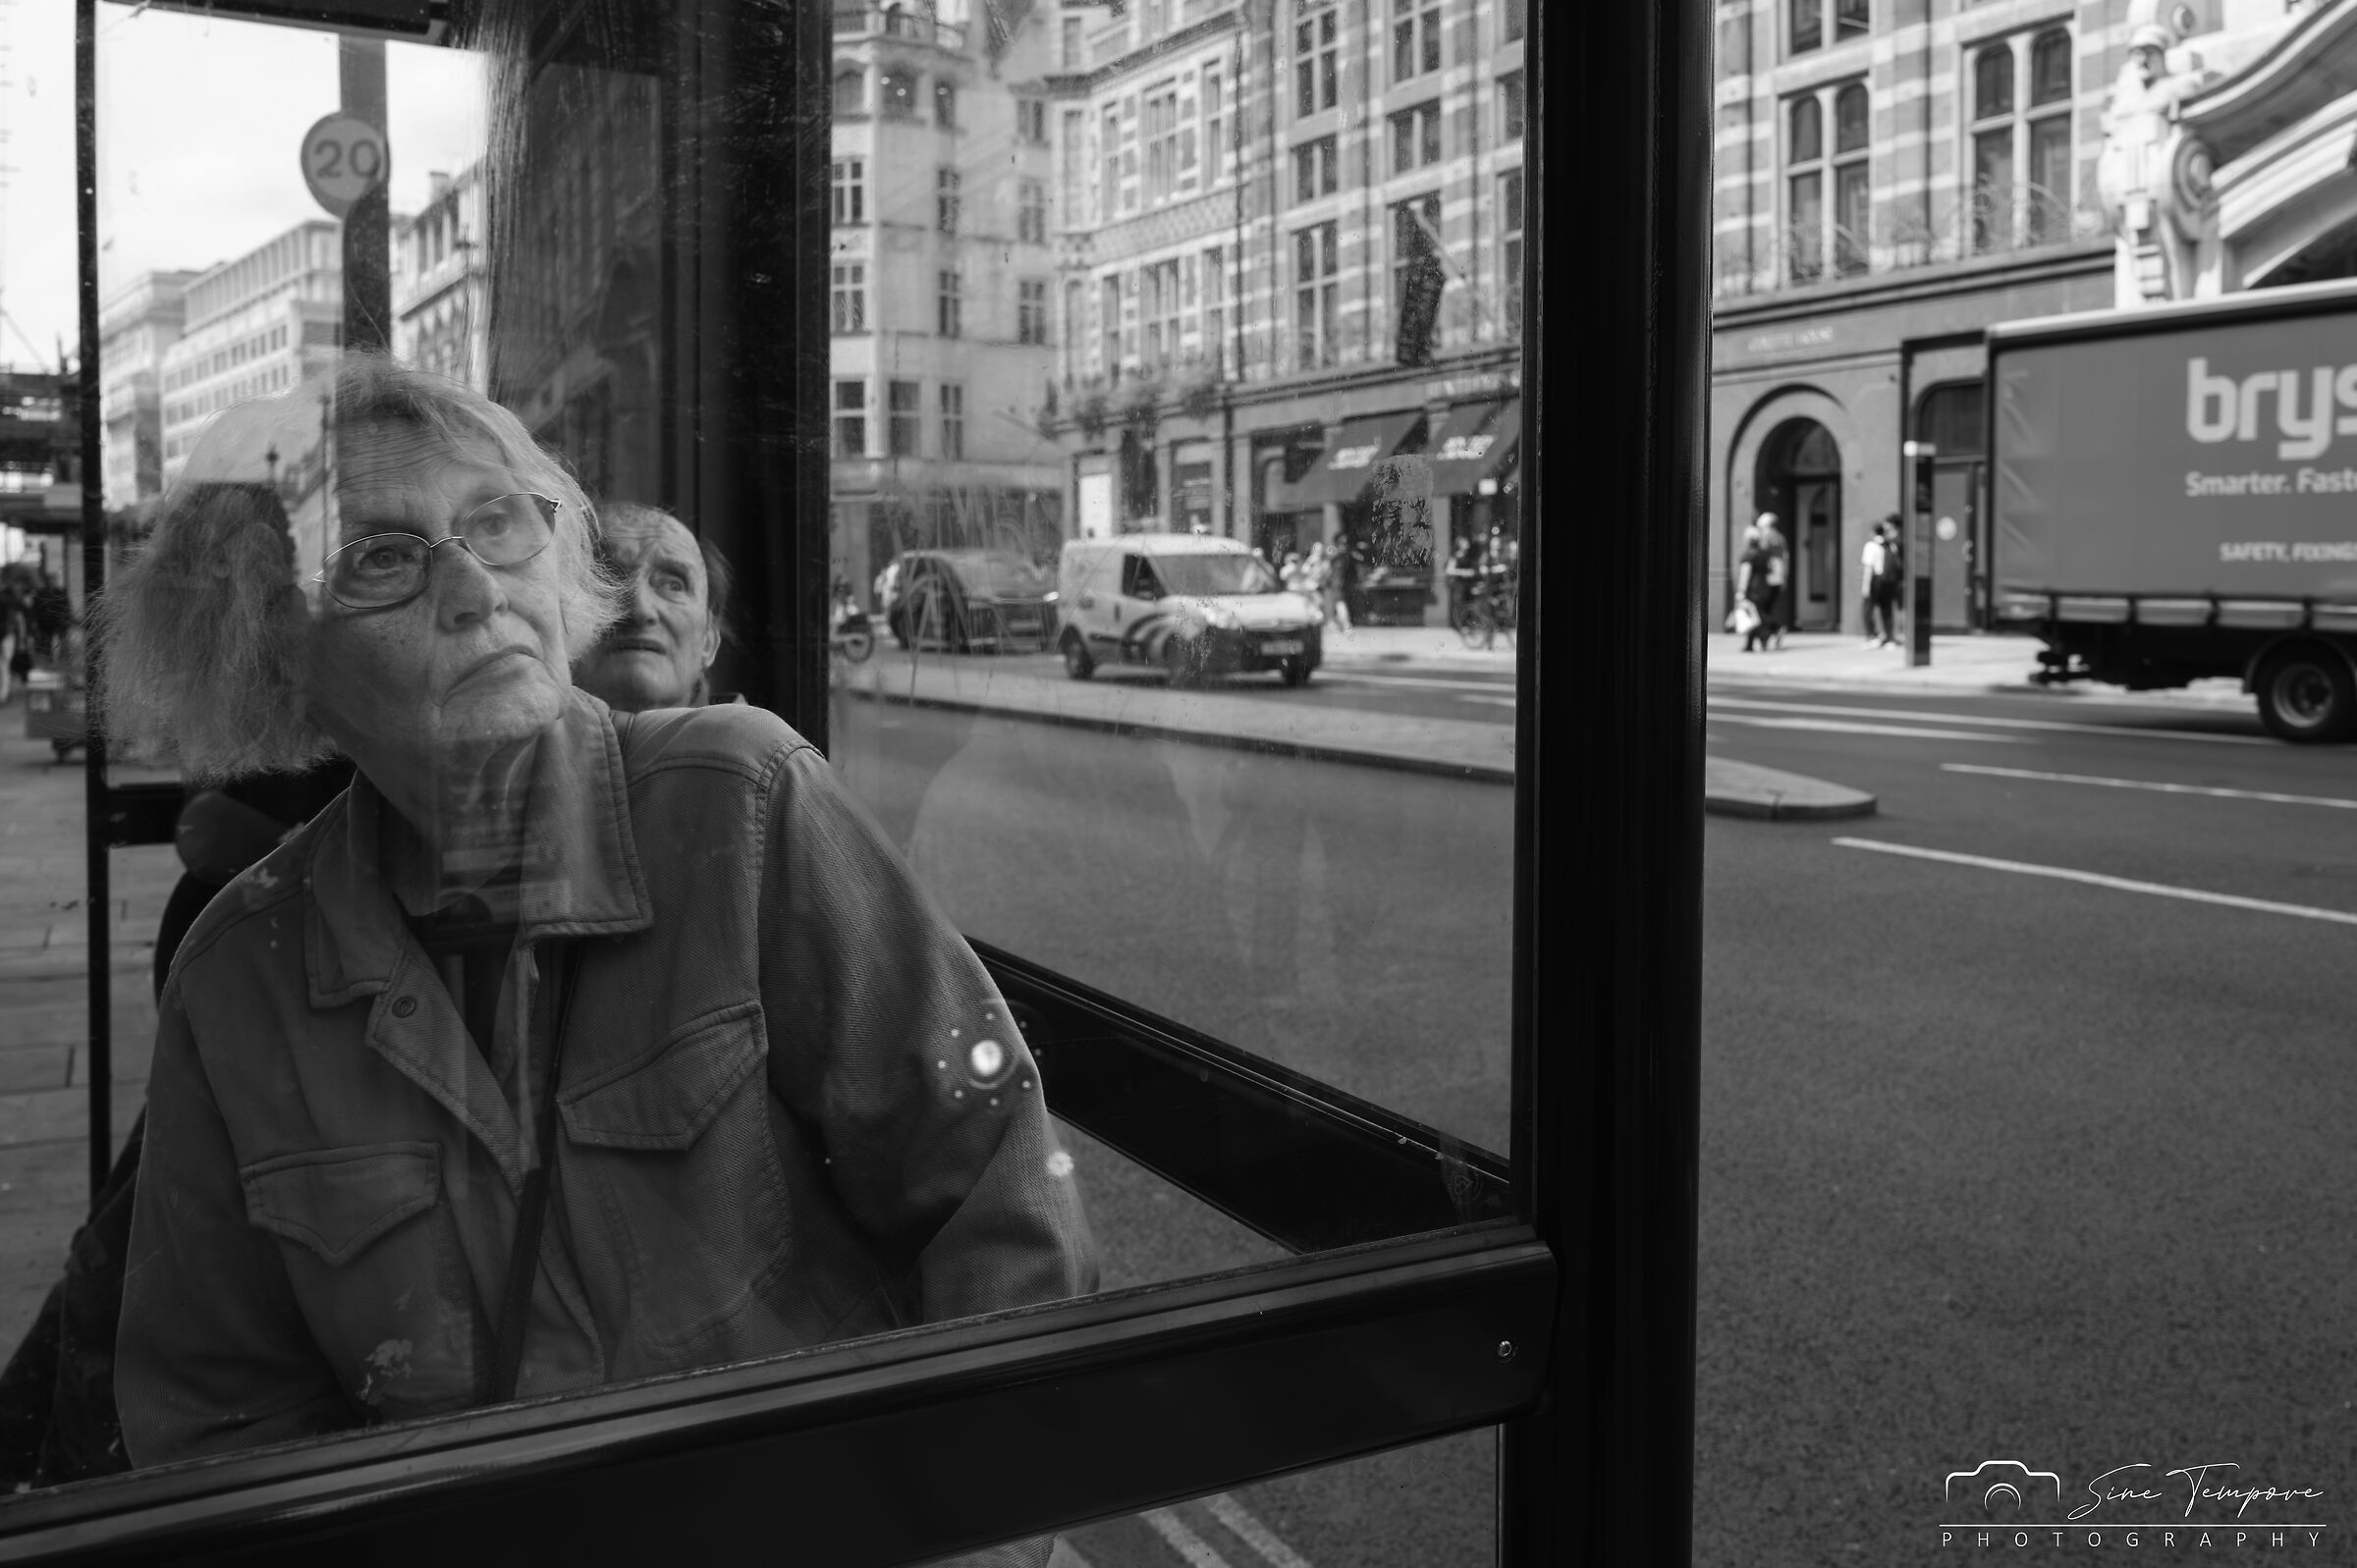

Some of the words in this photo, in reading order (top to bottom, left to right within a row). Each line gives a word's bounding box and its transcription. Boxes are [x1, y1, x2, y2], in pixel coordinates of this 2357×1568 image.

[314, 138, 381, 179] 20
[2185, 470, 2291, 497] Smarter.
[2220, 541, 2290, 563] SAFETY,
